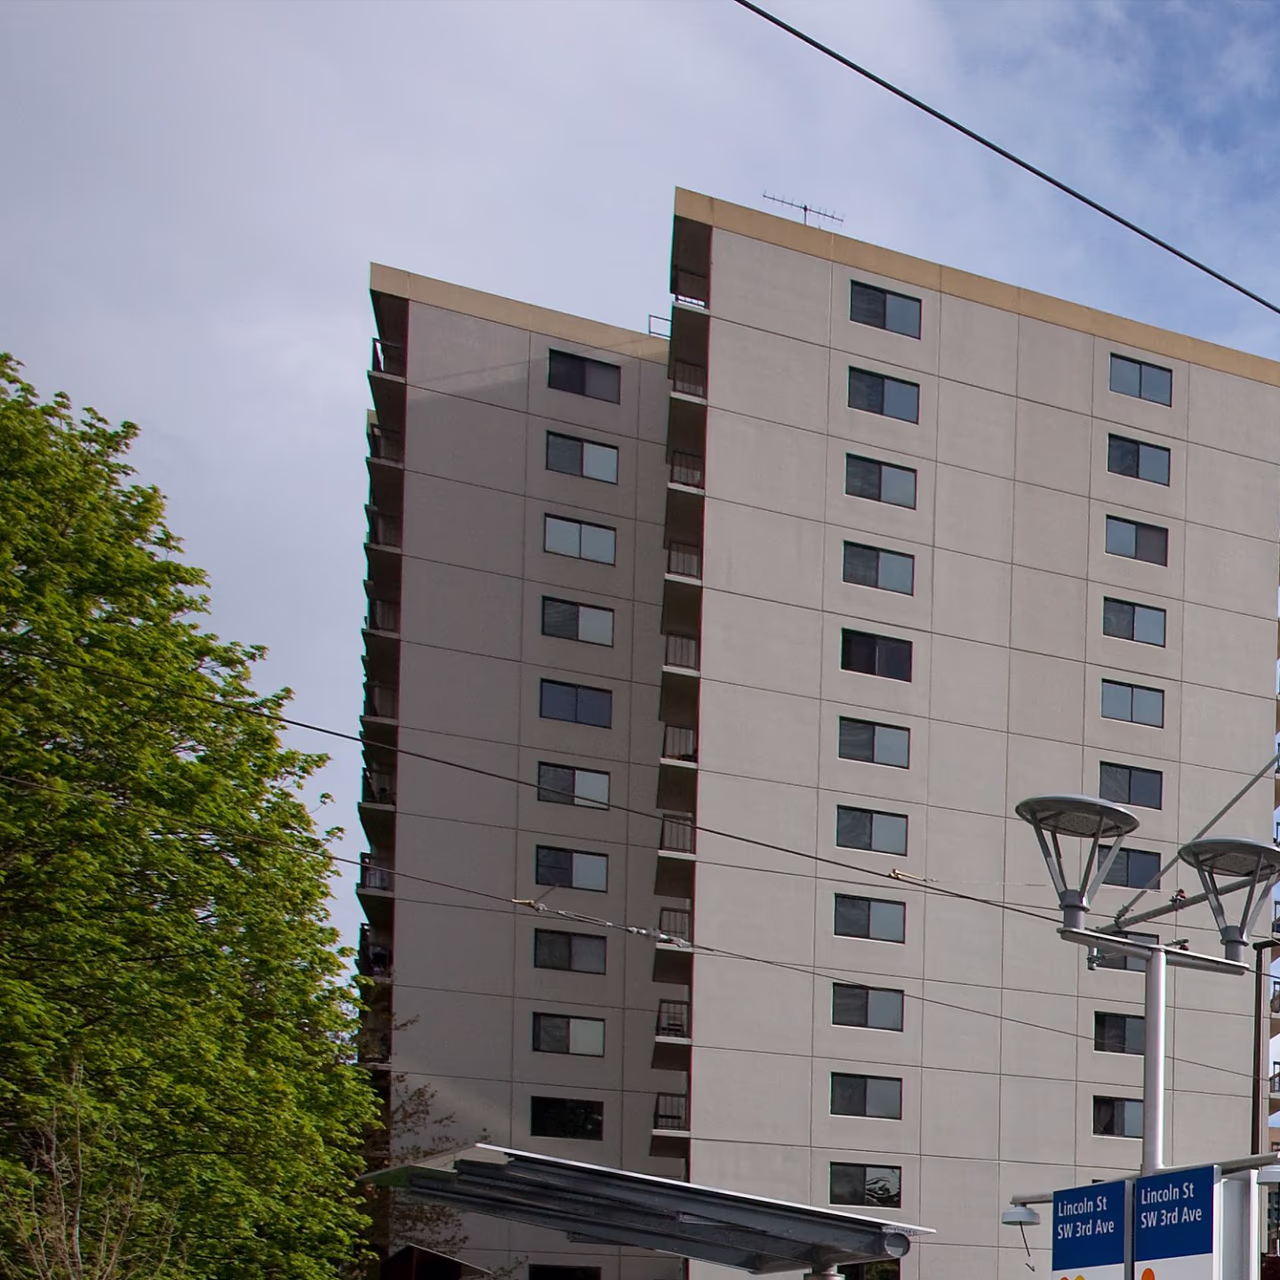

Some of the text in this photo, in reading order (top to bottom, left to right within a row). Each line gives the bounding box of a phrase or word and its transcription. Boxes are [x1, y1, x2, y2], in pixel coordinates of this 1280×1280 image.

[1141, 1182, 1194, 1205] Lincoln St
[1058, 1196, 1107, 1217] Lincoln St
[1141, 1206, 1202, 1229] SW 3rd Ave
[1057, 1219, 1115, 1240] SW 3rd Ave
